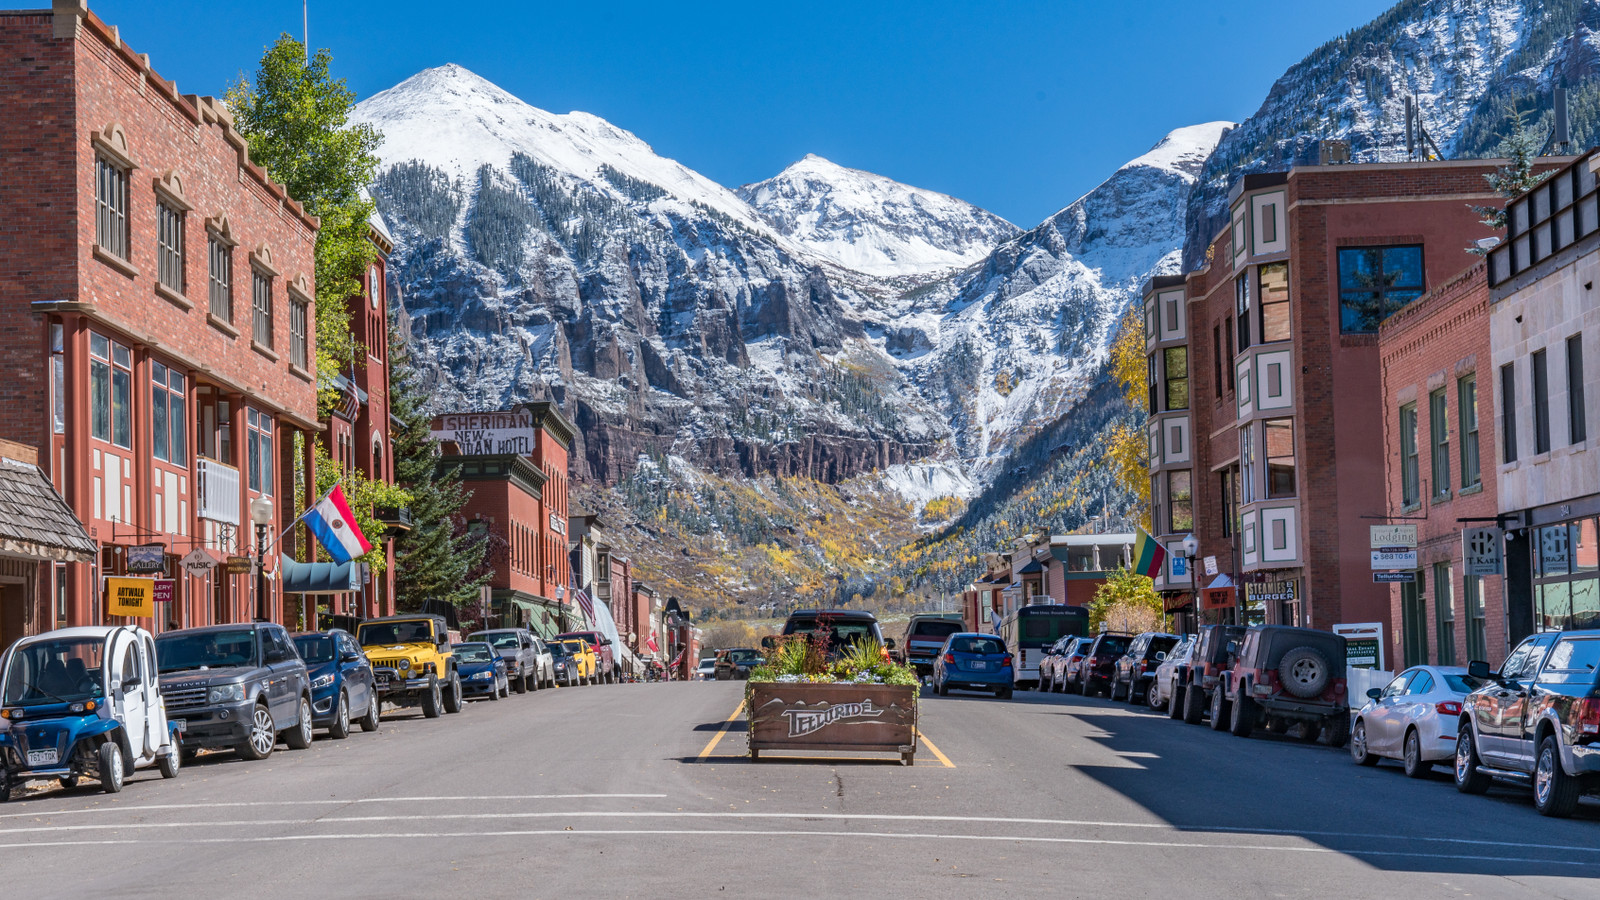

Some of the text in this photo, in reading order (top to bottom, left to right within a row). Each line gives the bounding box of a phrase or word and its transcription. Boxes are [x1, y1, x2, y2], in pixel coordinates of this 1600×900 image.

[446, 414, 529, 431] SHERIDAN
[454, 430, 485, 442] NEW
[498, 436, 531, 454] HOTEL
[1374, 532, 1414, 543] Lodging
[131, 561, 161, 569] GALLERY
[186, 561, 212, 569] MUSIC
[117, 586, 145, 598] ARTWALK
[1248, 582, 1286, 595] STEAMIES
[118, 597, 143, 607] TONIGHT
[781, 703, 884, 738] TELLURIDE
